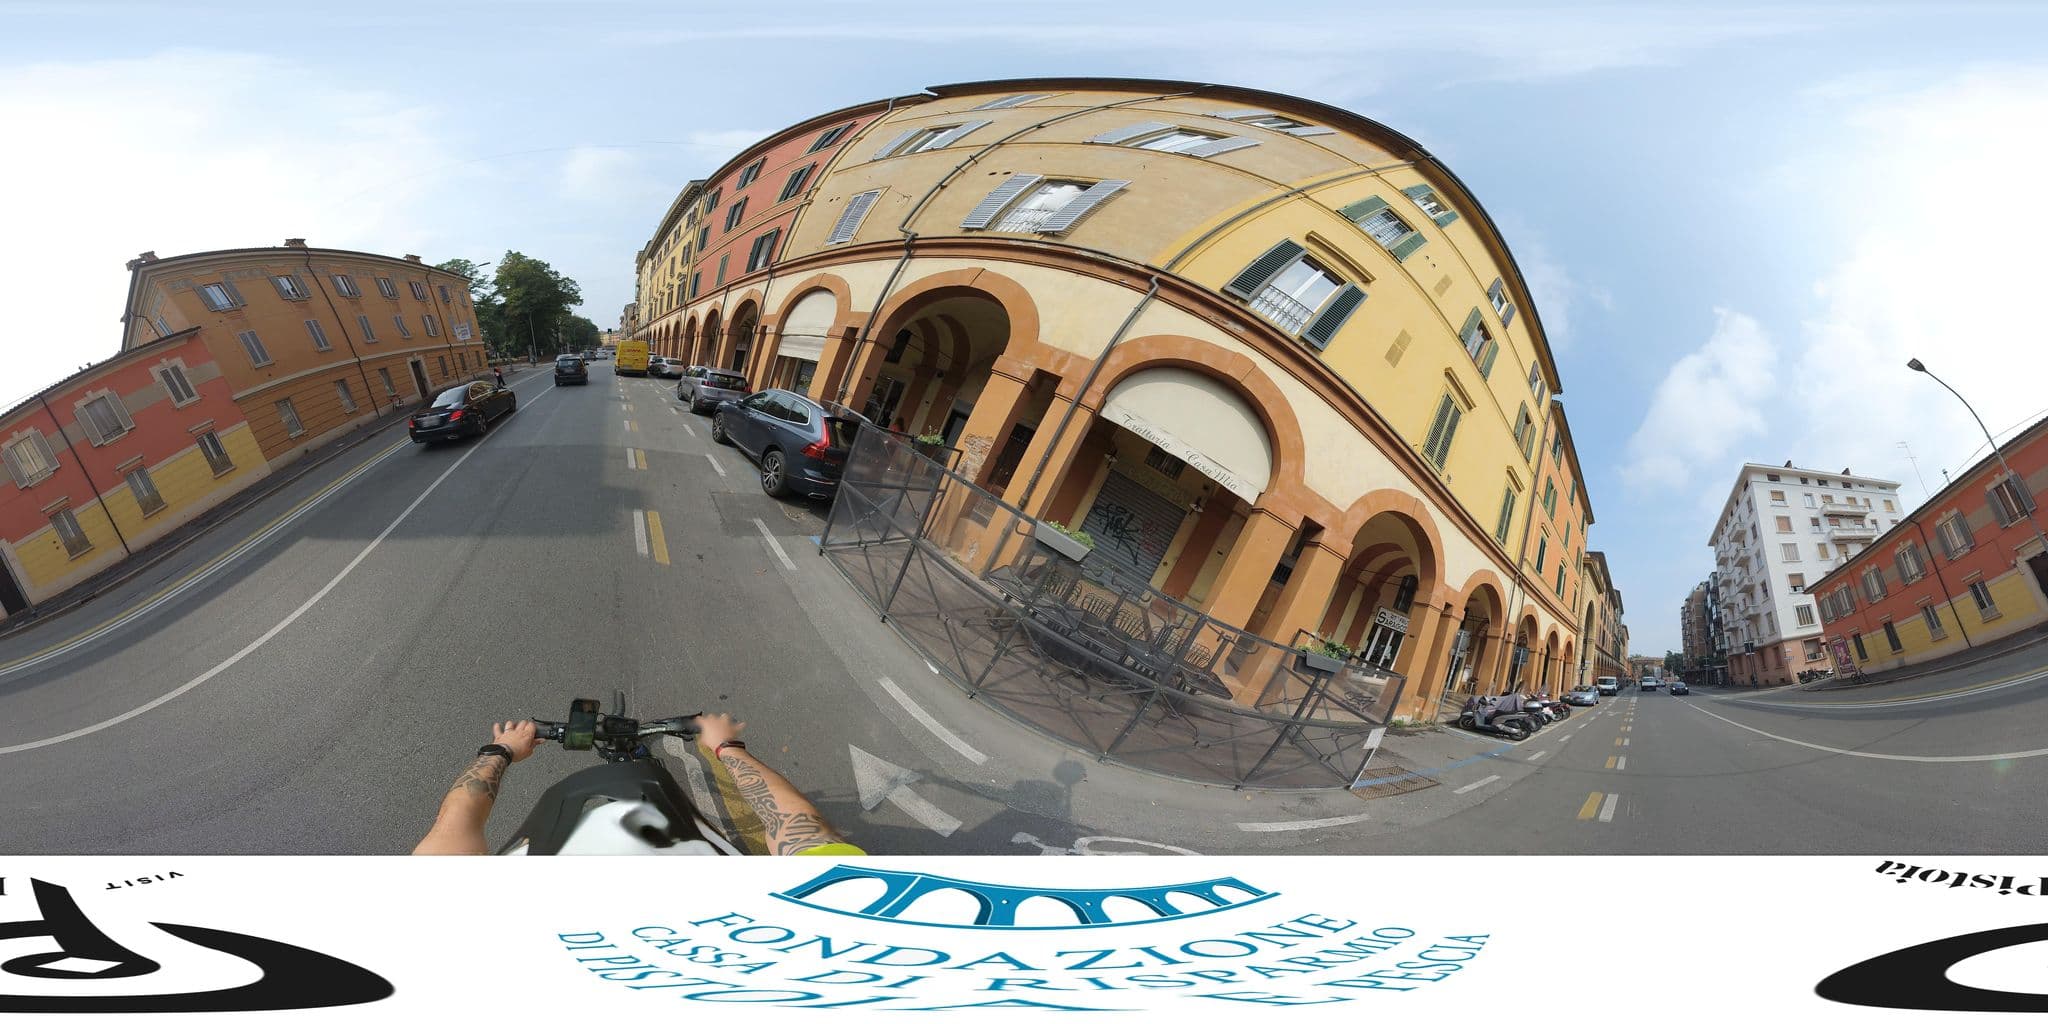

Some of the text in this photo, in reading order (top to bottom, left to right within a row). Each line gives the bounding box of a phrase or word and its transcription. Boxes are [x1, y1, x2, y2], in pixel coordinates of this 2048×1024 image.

[1122, 413, 1239, 490] Trattoria Casa Mia
